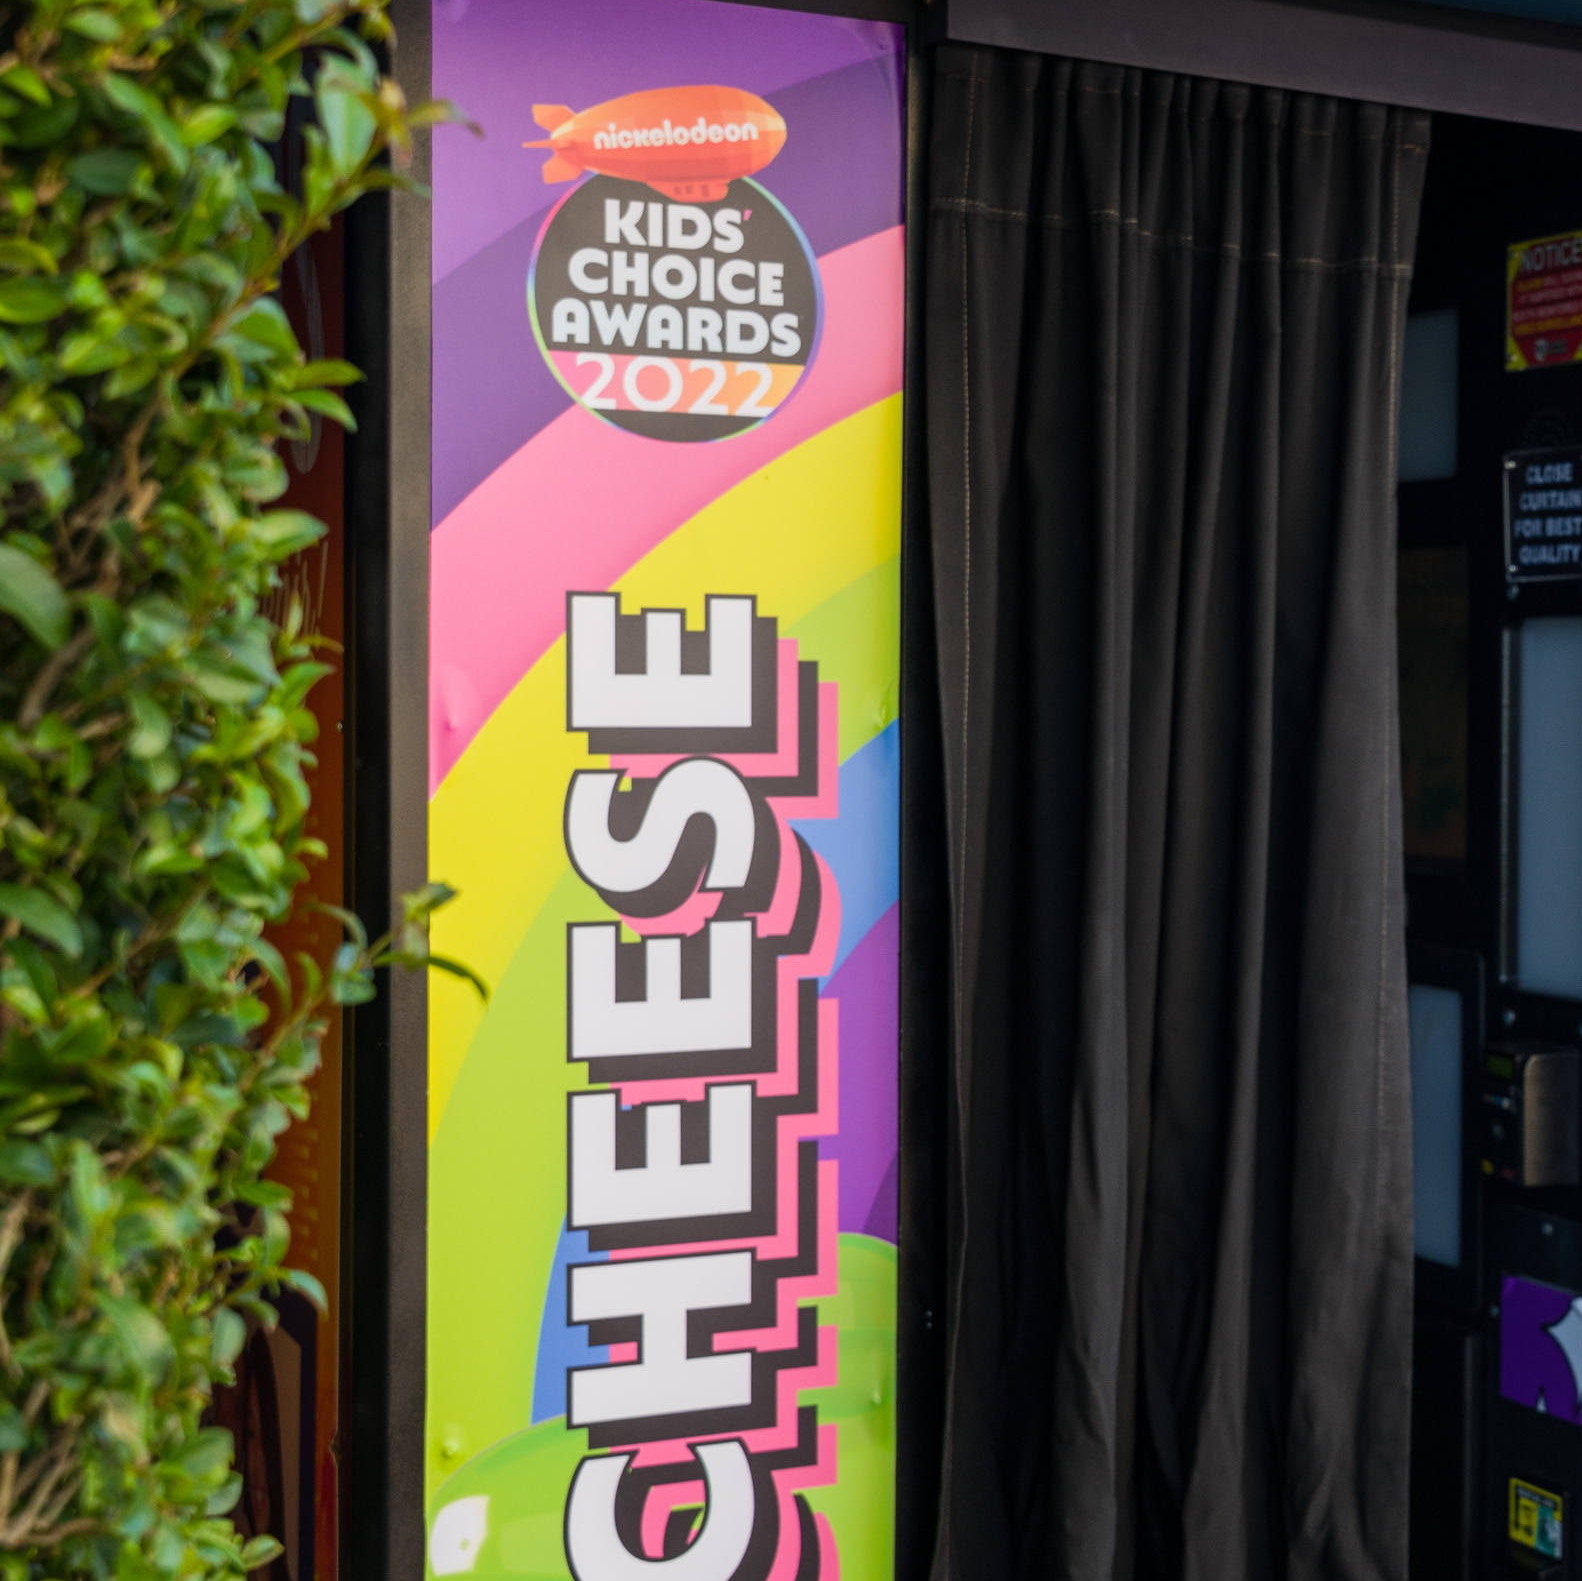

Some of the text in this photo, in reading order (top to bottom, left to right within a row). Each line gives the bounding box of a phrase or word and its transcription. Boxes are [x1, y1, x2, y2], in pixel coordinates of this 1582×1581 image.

[593, 117, 759, 150] nickelodeon
[604, 199, 752, 253] KIDS'
[1519, 241, 1582, 273] NOTICE
[568, 247, 784, 307] CHOICE
[552, 297, 802, 357] AWARDS
[575, 351, 775, 418] 2022
[1525, 461, 1574, 485] CLOSE
[1519, 488, 1582, 512] CURTAIN
[1513, 517, 1543, 539] FOR
[1518, 542, 1582, 566] QUALITY
